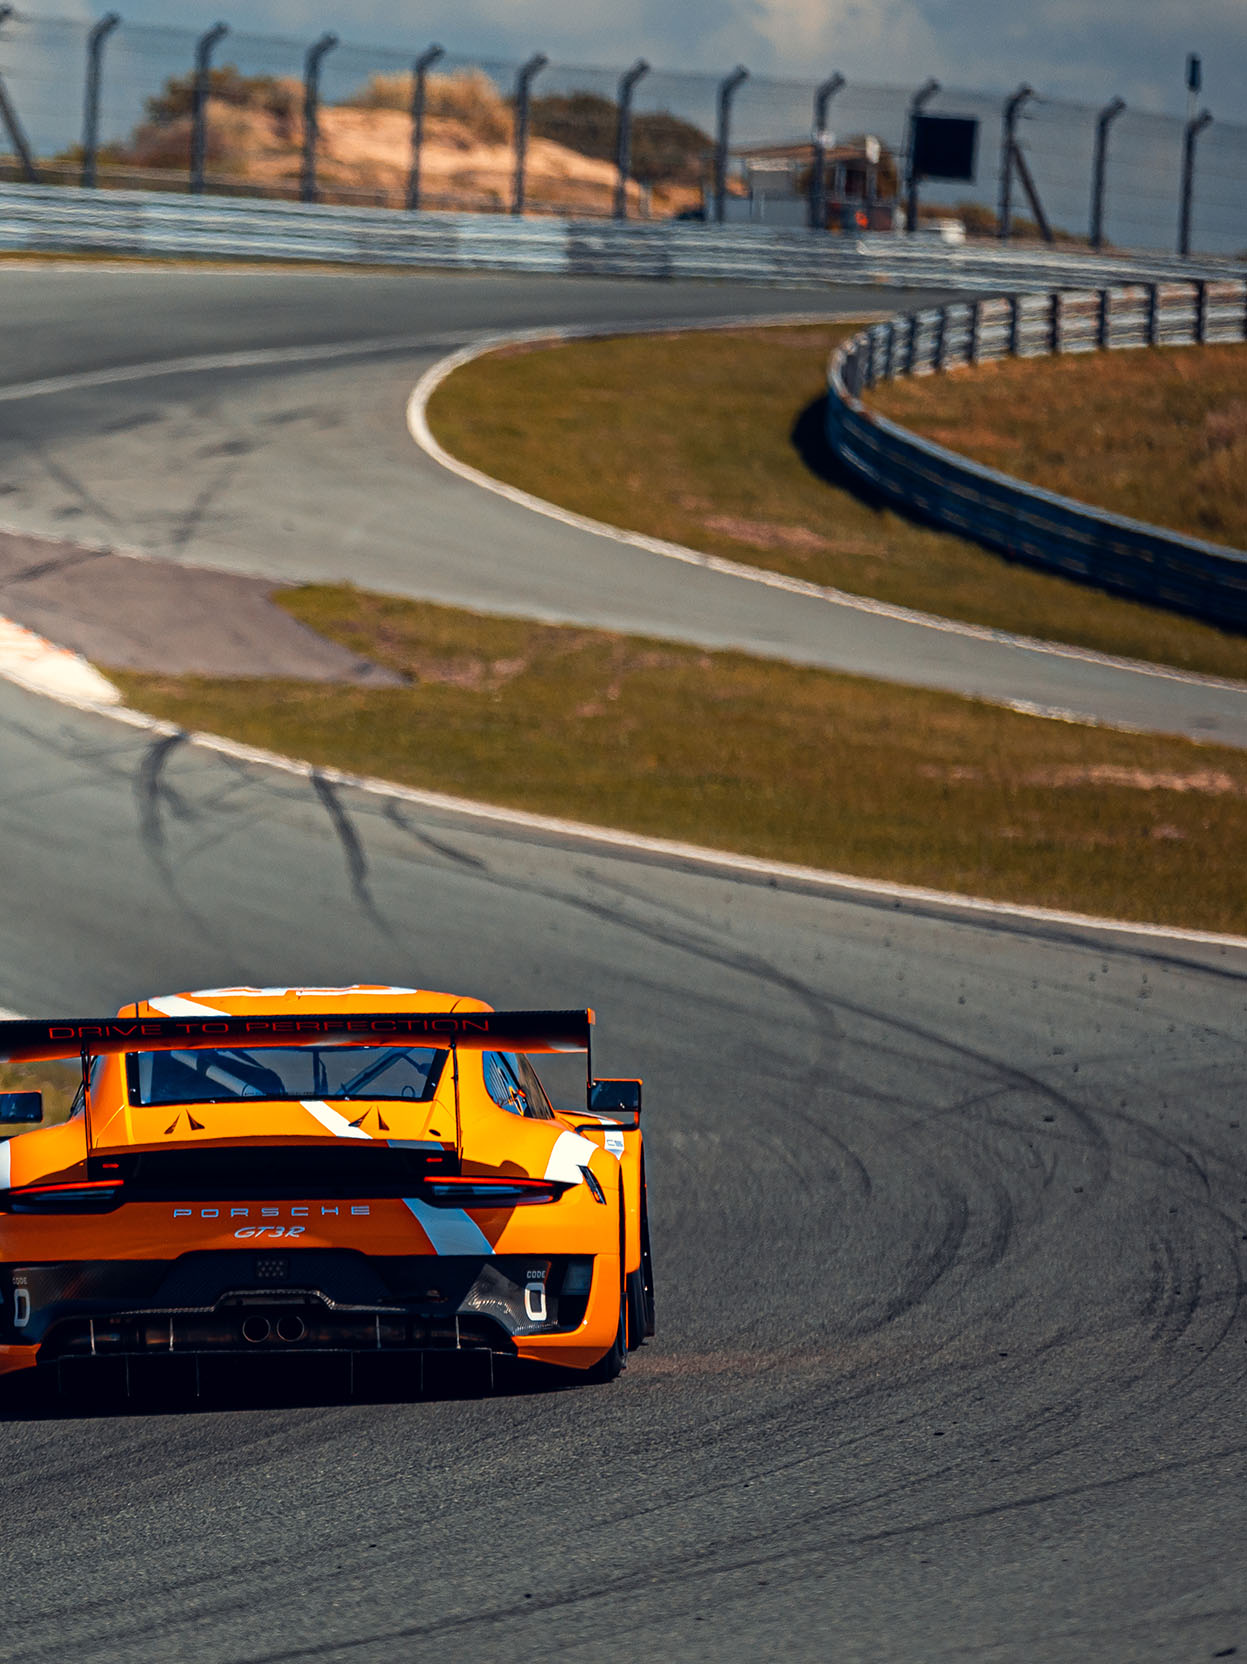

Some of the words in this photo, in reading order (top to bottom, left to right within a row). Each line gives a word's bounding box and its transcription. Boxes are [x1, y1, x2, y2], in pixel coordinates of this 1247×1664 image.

[48, 1024, 162, 1039] DRIVE
[175, 1022, 229, 1034] TO
[245, 1018, 490, 1033] PERFECTION
[173, 1205, 370, 1218] PORSCHE
[526, 1270, 546, 1279] CODE
